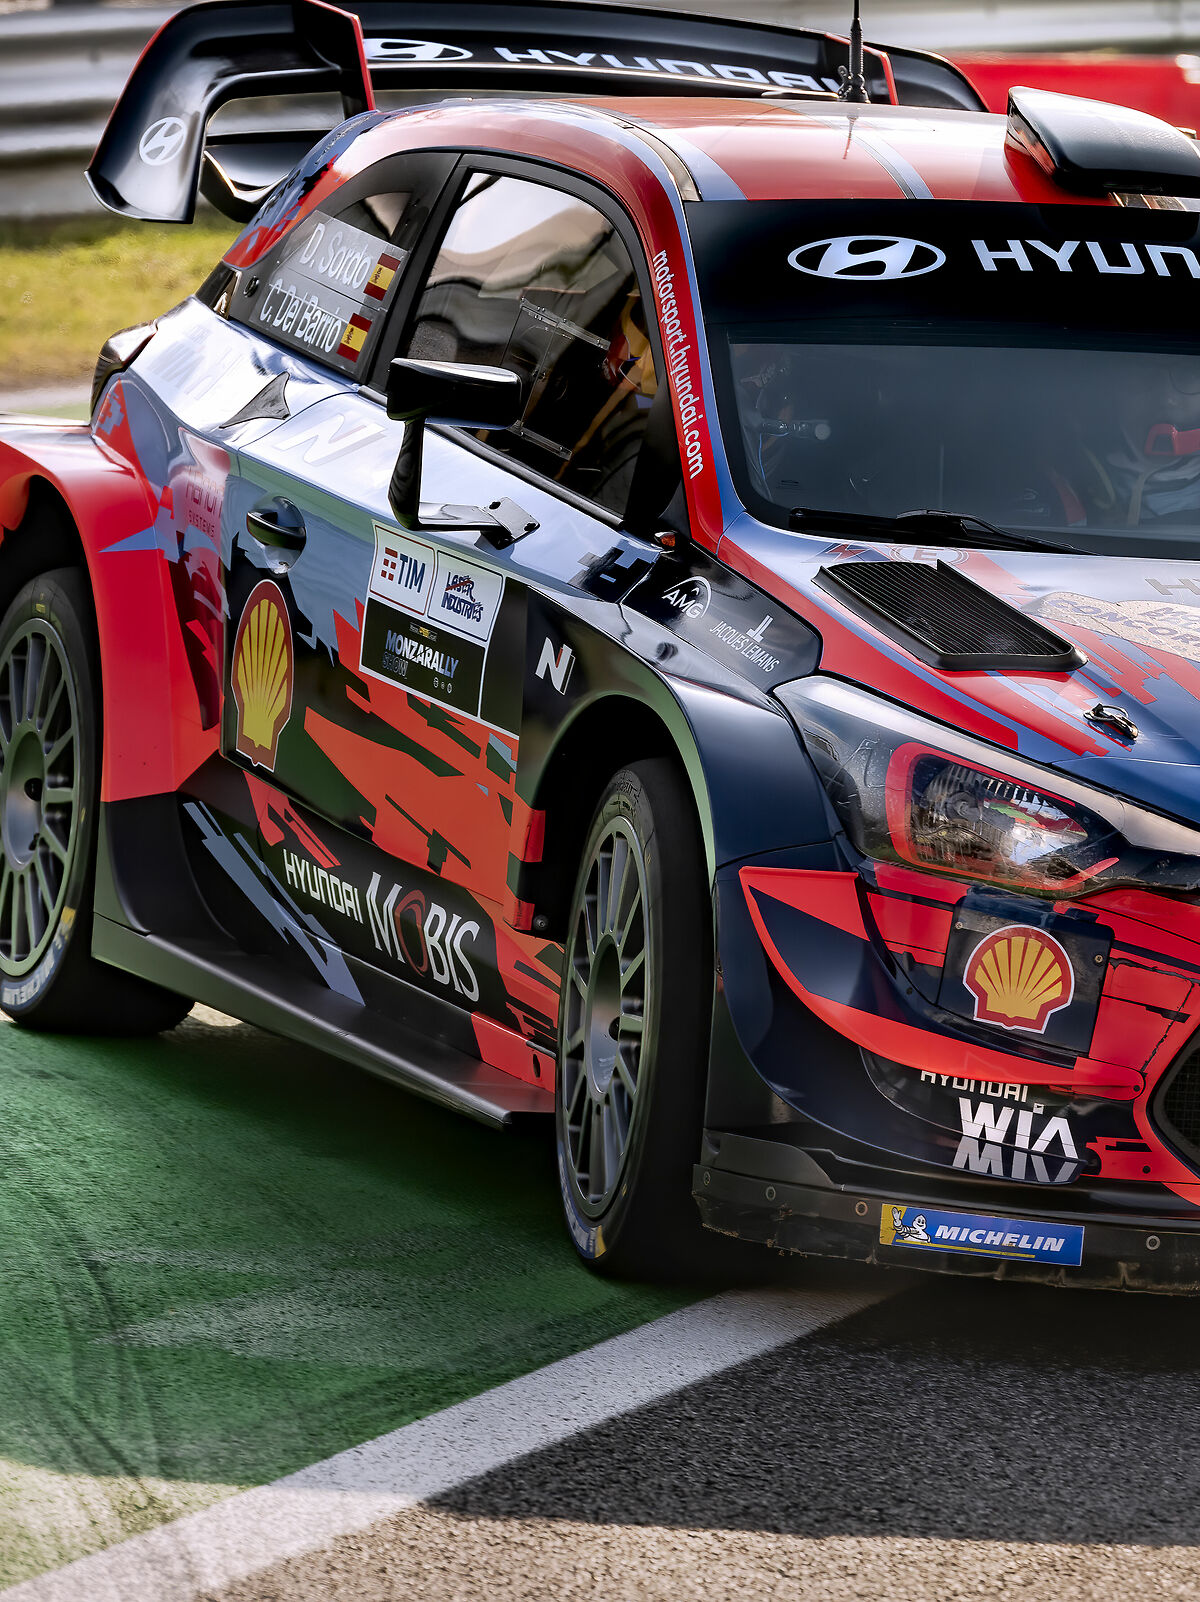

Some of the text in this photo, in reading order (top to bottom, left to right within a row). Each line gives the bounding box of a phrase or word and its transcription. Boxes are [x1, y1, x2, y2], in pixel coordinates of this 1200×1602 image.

[299, 222, 373, 289] D. Sordo
[259, 278, 342, 353] C. Del Barrio
[652, 249, 704, 480] motorsport.hyundai.com
[397, 552, 426, 594] TIM
[661, 588, 704, 619] AMG
[709, 620, 781, 673] JACQUES LEMANS
[282, 848, 481, 1003] HYUNDAI MOBIS
[934, 1223, 1066, 1253] MICHELIN
